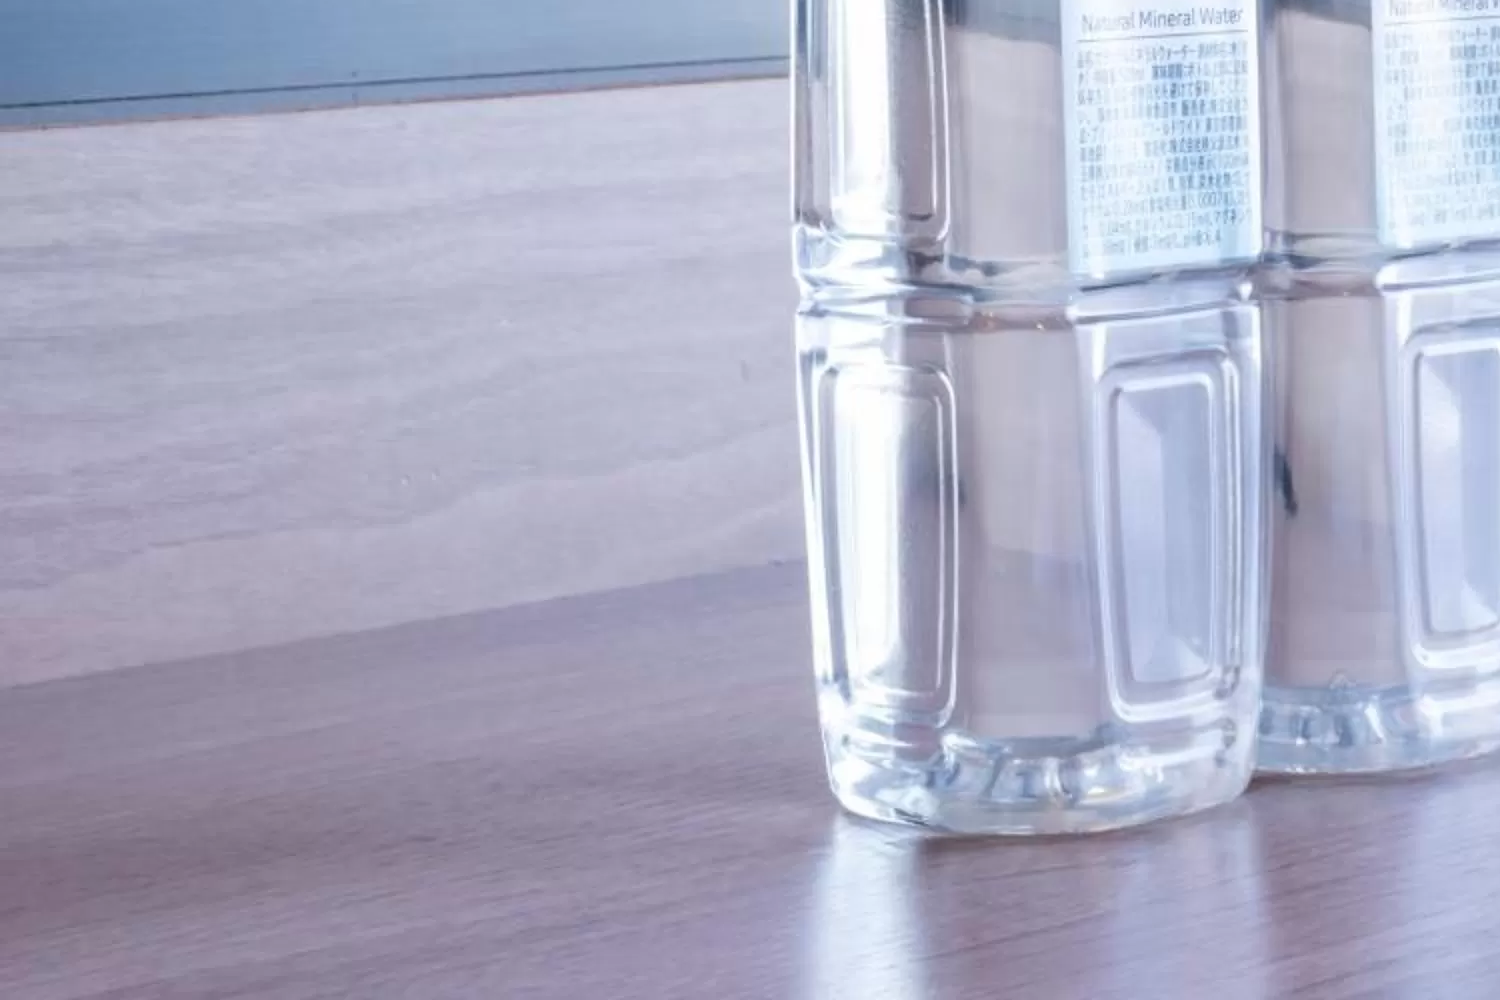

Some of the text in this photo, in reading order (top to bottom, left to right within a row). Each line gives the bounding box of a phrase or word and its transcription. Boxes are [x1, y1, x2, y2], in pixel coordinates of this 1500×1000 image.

[1082, 7, 1244, 33] Natural Mineral Water
